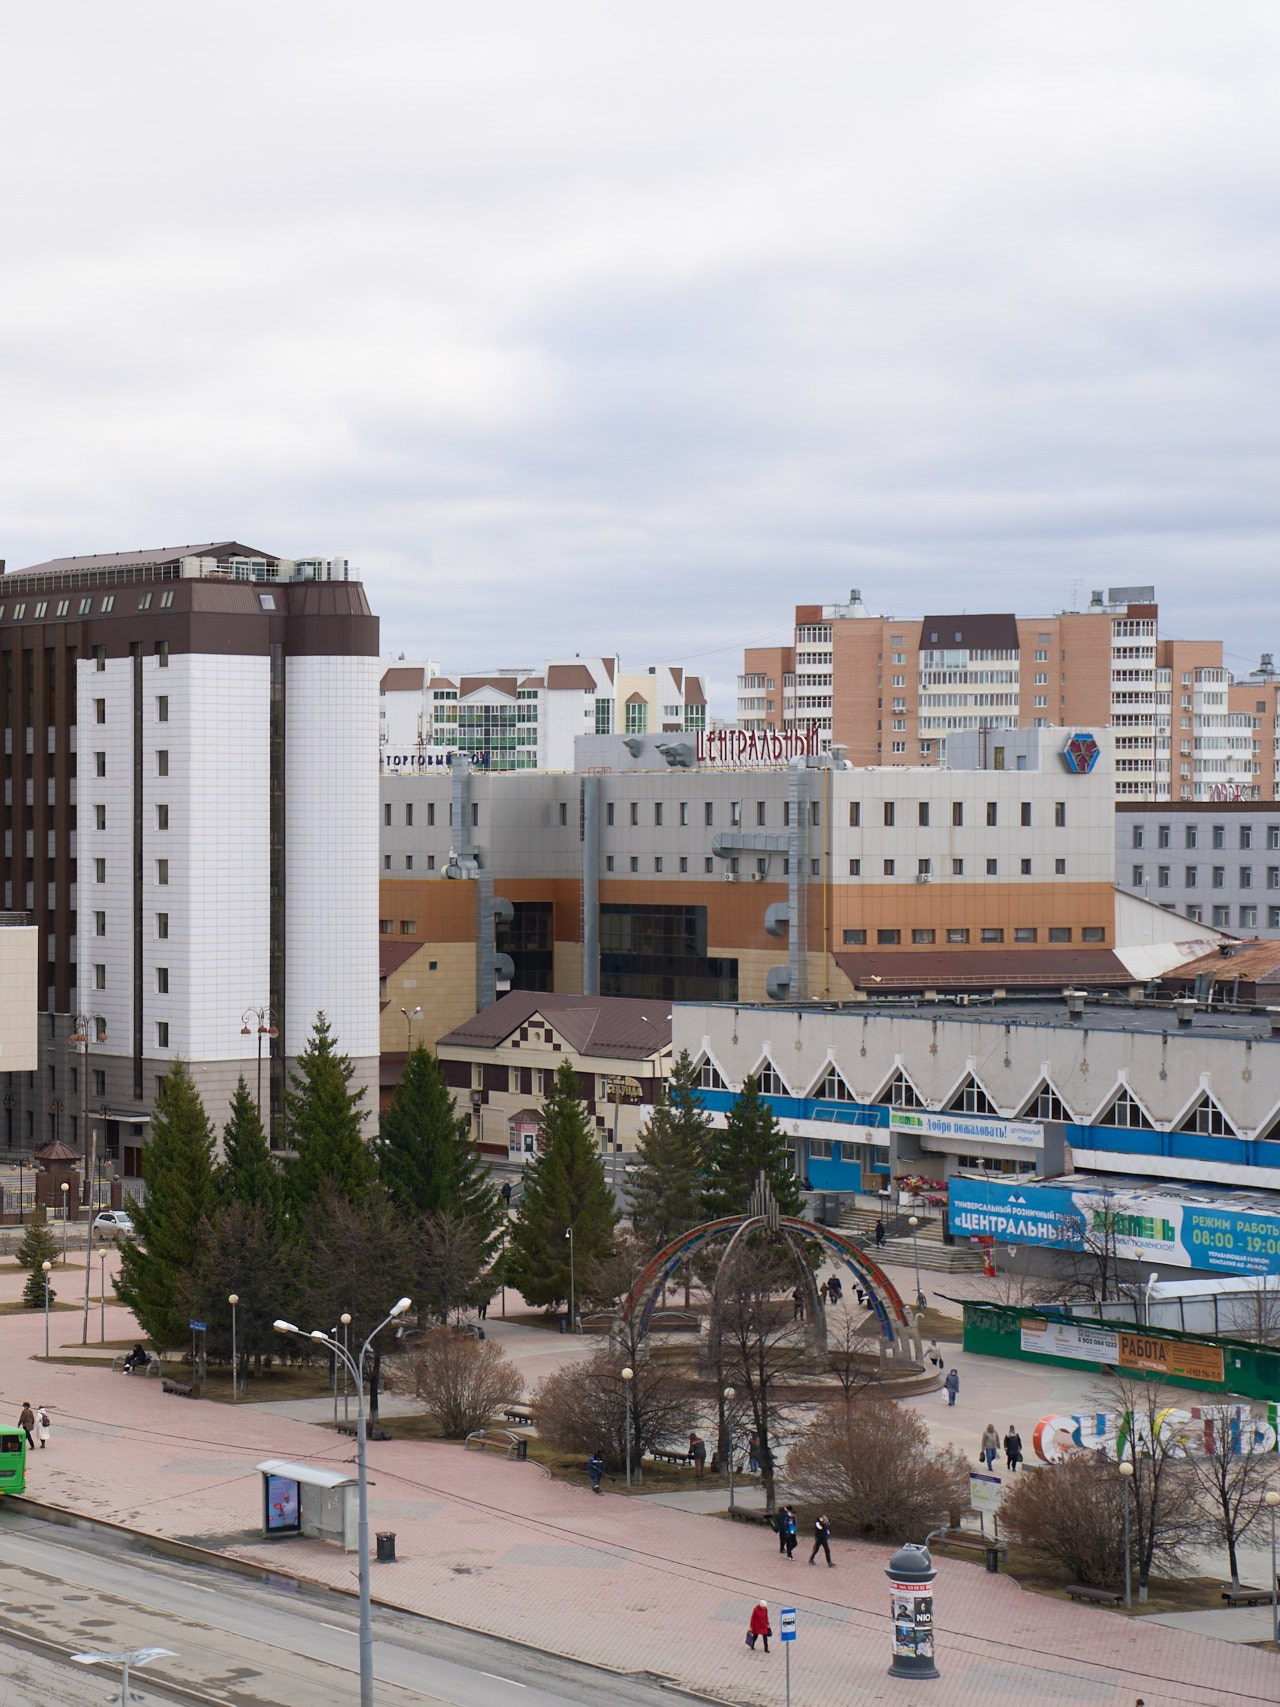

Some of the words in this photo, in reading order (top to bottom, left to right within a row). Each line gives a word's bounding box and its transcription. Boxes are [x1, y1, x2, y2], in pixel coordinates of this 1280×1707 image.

[696, 721, 820, 761] ЦЕНТРАЛЬНЫЙ
[927, 1119, 951, 1133] Добро
[954, 1122, 1007, 1138] пожаловать!
[954, 1200, 1012, 1214] УНИВЕРСАЛЬНЫЙ
[1012, 1206, 1055, 1220] РОЗНИЧНЫЙ
[1192, 1215, 1231, 1230] РЕЖИМ
[1192, 1229, 1234, 1248] 08:00
[1122, 1337, 1166, 1361] РАБОТА
[1033, 1402, 1280, 1464] СЧАСТЬ
